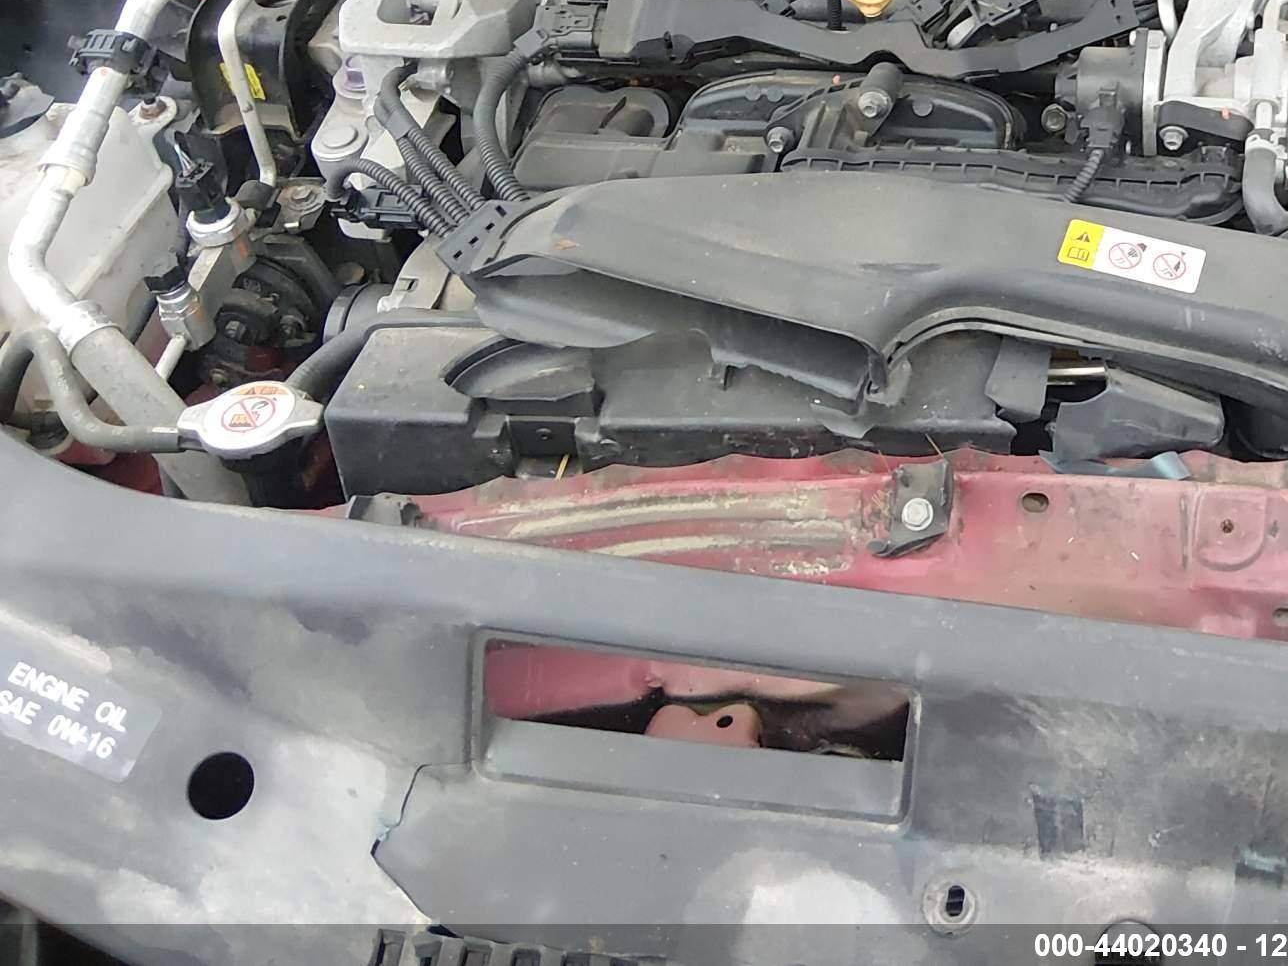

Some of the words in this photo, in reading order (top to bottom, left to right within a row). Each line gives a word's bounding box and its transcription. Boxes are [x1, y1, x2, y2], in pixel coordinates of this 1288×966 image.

[0, 690, 41, 725] SAE
[47, 714, 116, 759] 0W-16
[8, 661, 89, 712] ENGINE
[95, 701, 127, 732] OIL
